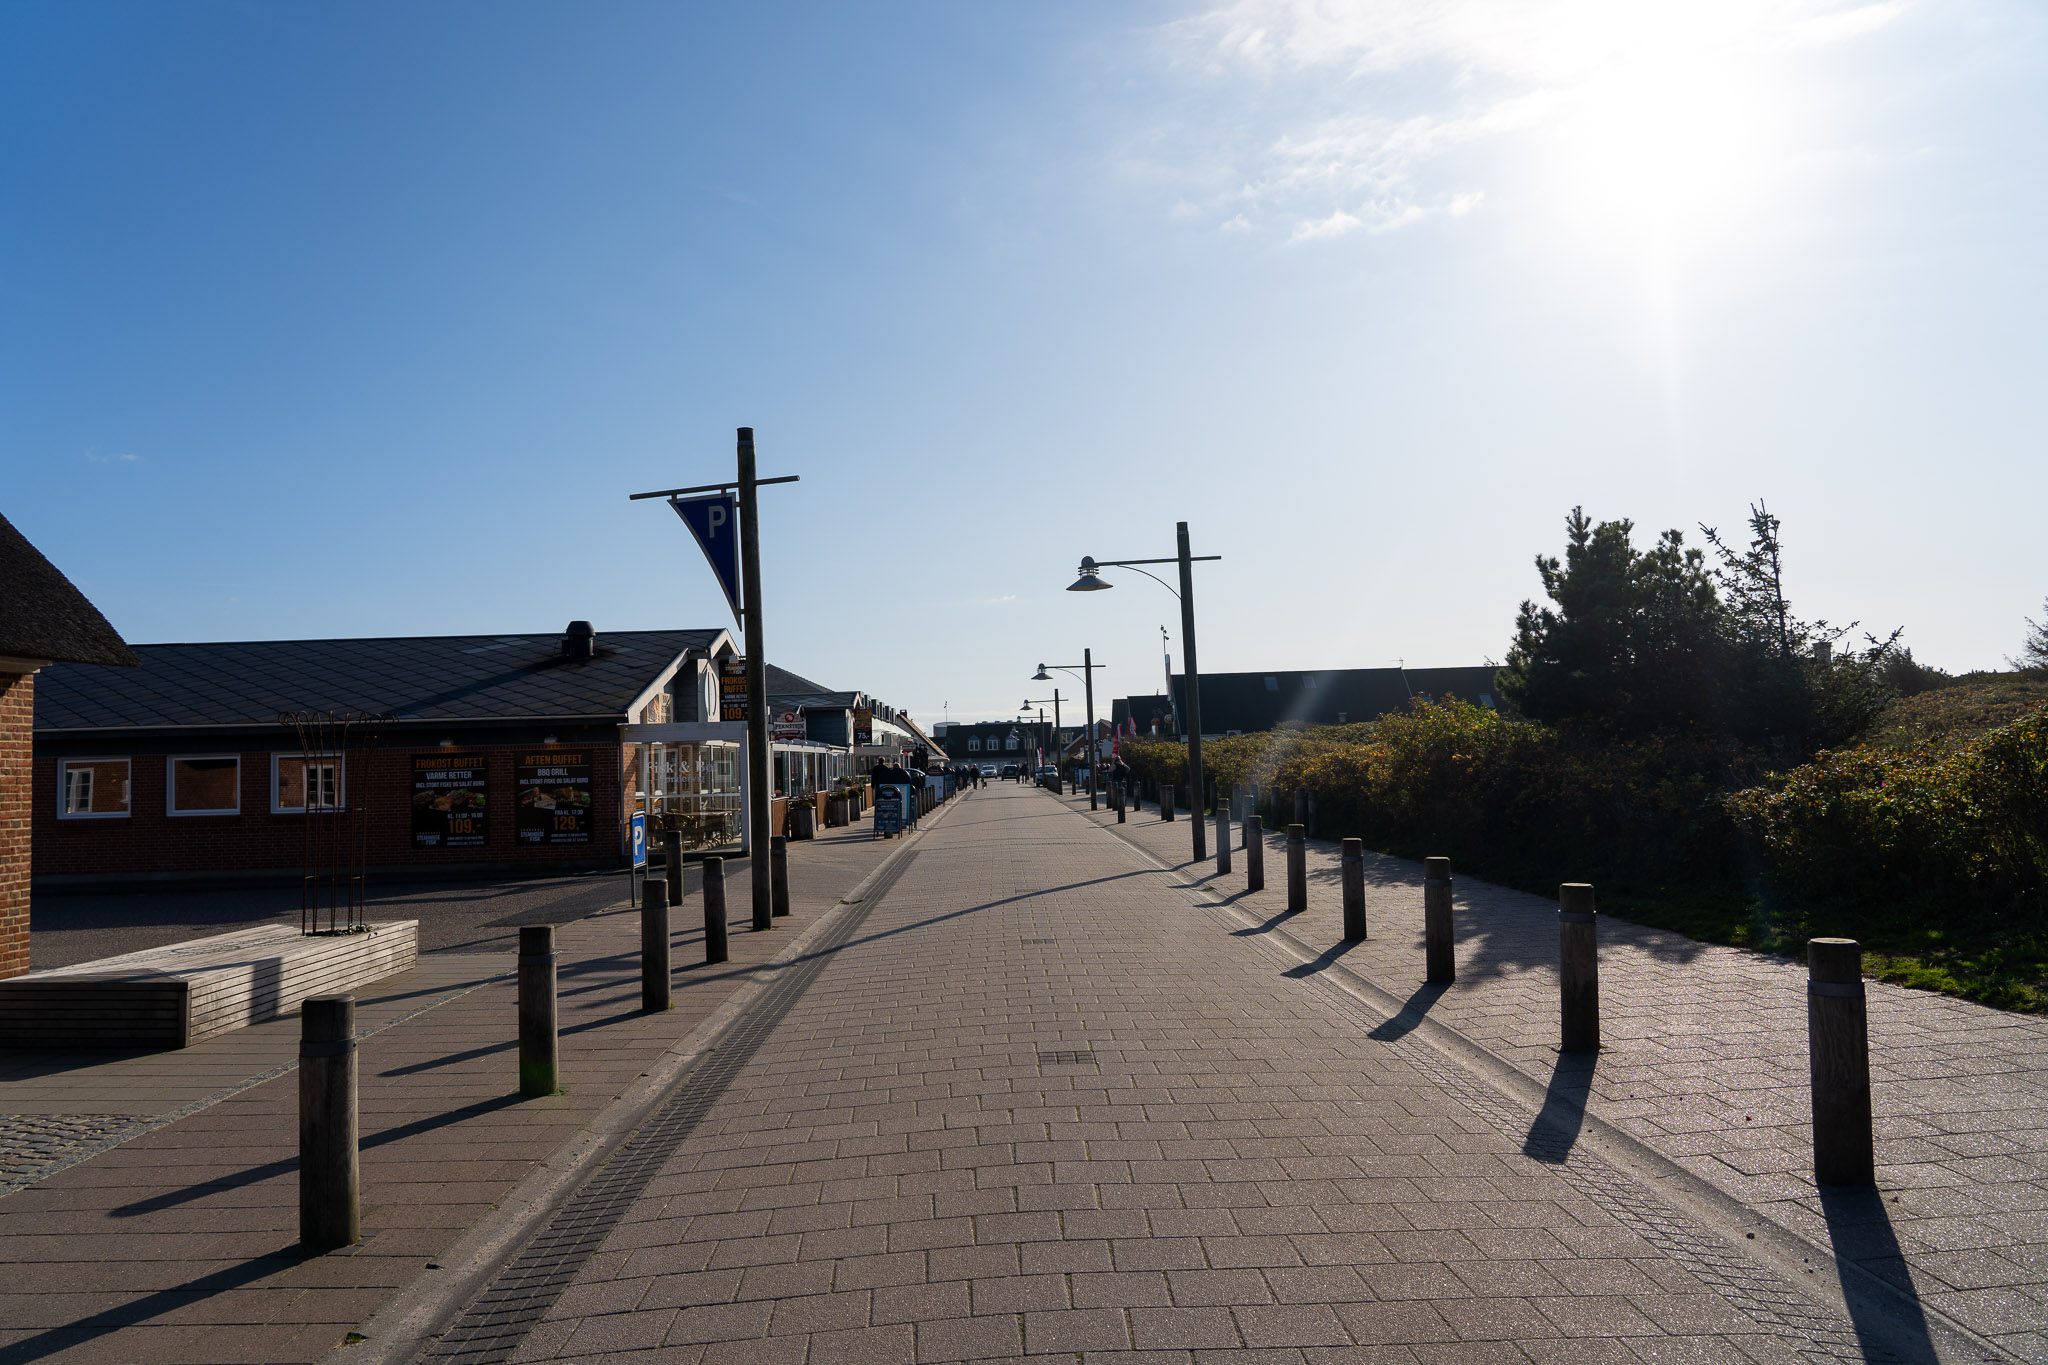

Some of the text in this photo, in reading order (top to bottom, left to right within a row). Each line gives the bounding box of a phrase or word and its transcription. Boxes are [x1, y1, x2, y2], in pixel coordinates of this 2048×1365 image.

[708, 505, 727, 538] P
[721, 676, 747, 685] FROKOS
[857, 732, 870, 740] 75,-
[416, 756, 484, 768] FROKOST BUFFET
[525, 754, 583, 766] AFTEN BUFFET
[680, 760, 690, 772] &
[425, 770, 472, 780] VARME RETTER
[537, 767, 569, 777] BBQ GRILL
[448, 818, 482, 835] 109,-
[553, 815, 585, 832] 129,-
[634, 825, 643, 857] P
